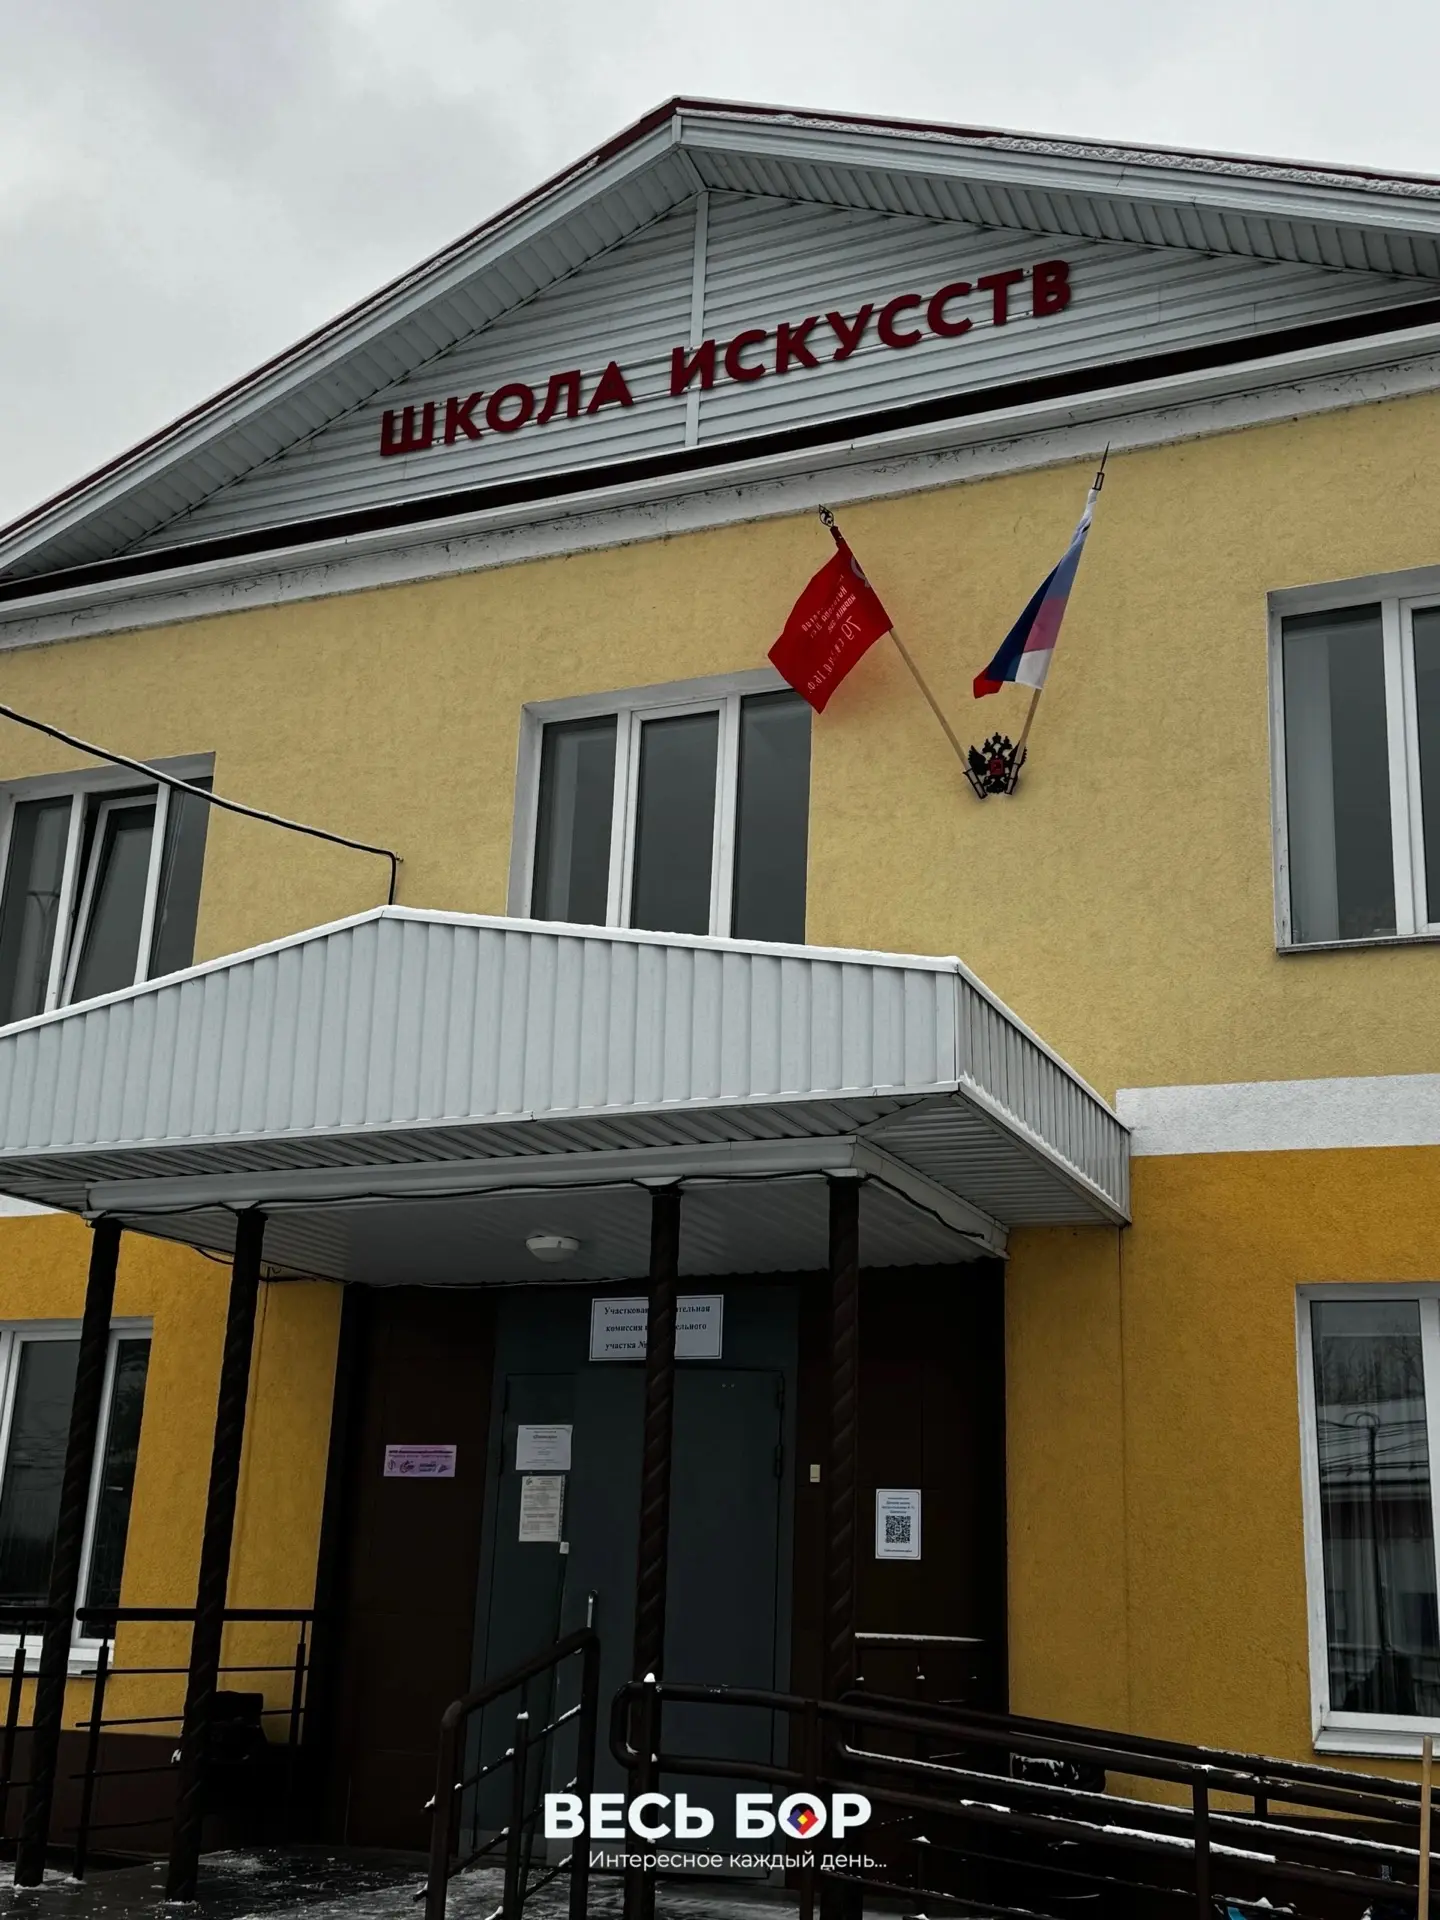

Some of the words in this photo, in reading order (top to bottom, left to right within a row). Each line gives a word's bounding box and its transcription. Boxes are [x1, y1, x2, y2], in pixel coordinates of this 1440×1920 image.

[380, 360, 633, 456] ШКОЛА
[670, 260, 1071, 397] ИСКУССТВ
[604, 1342, 636, 1351] участка
